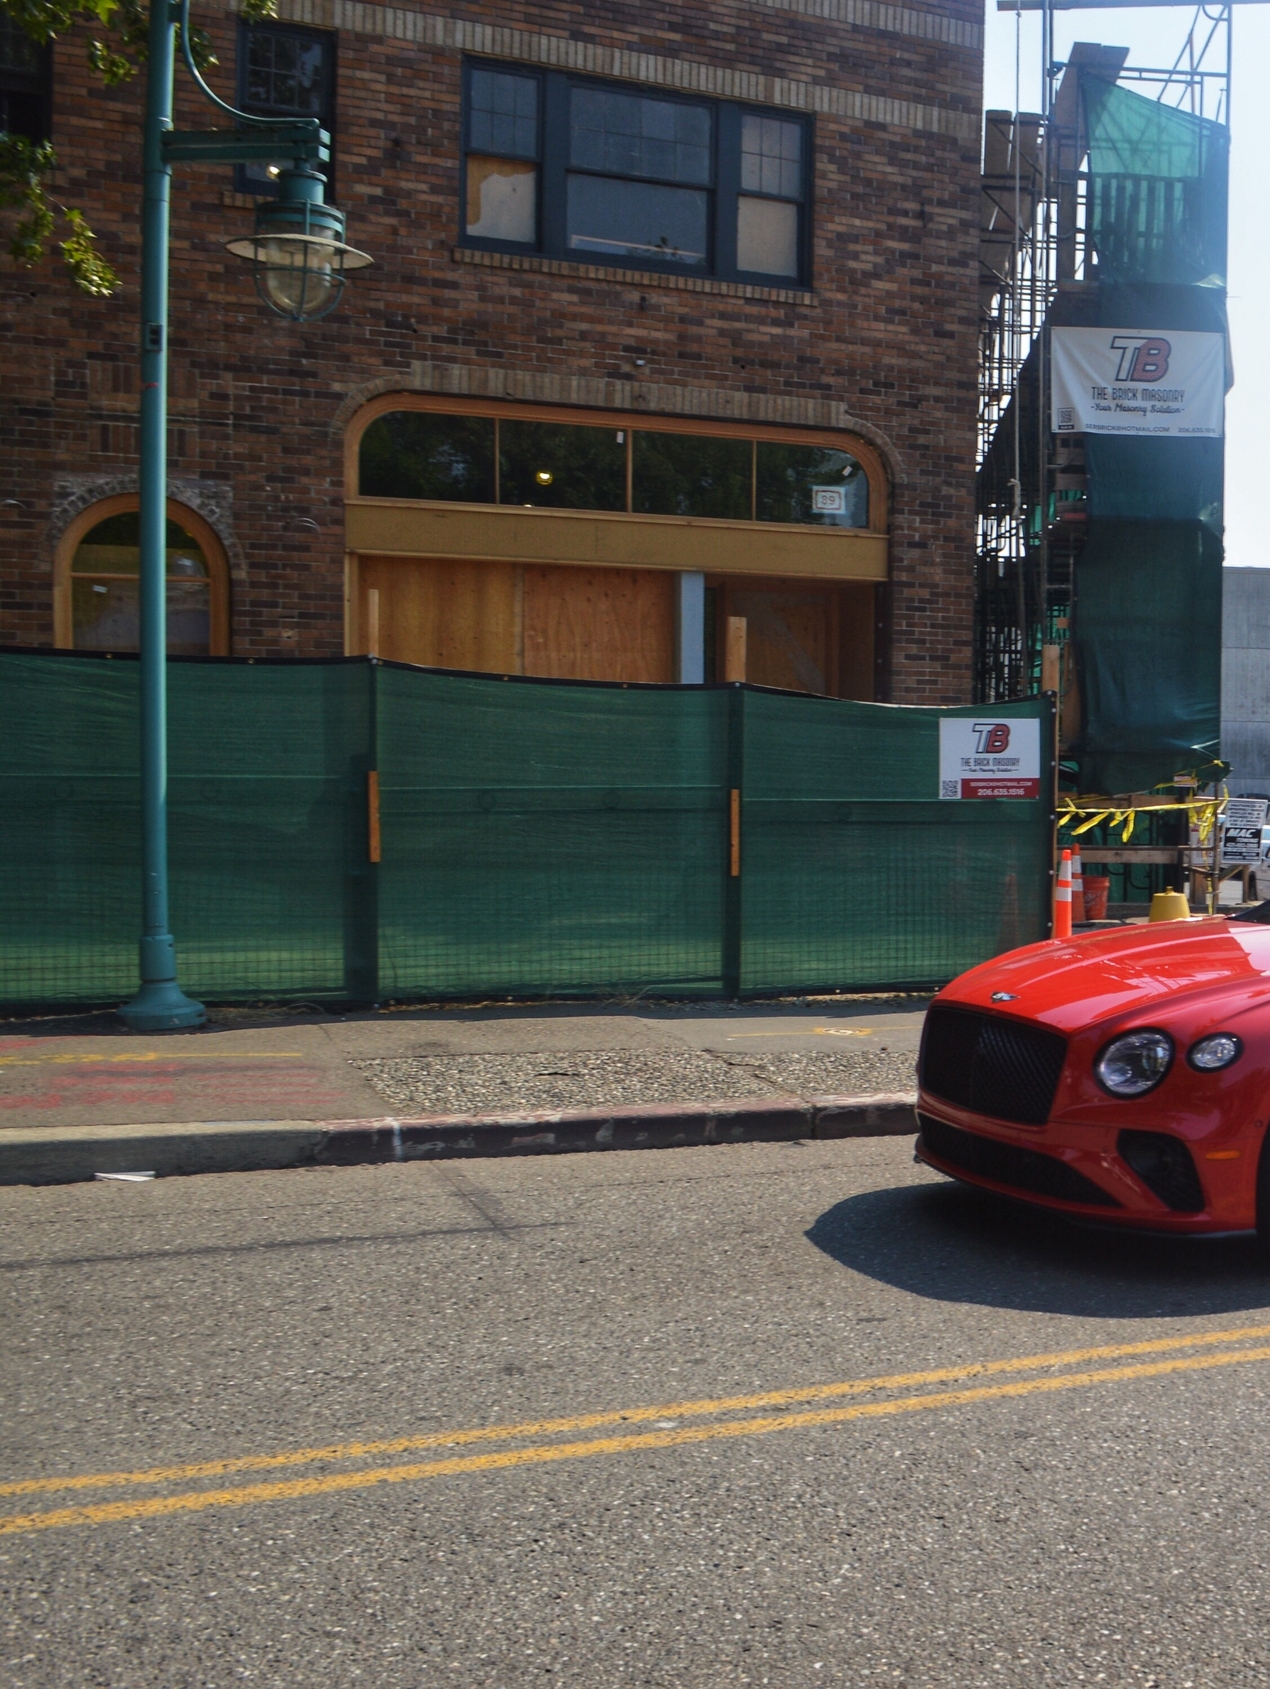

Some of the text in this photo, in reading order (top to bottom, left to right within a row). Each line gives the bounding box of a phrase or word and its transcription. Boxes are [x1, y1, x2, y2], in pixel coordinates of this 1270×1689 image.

[1110, 335, 1172, 383] TB
[1091, 386, 1186, 403] THE BRICK MASONRY
[1114, 402, 1147, 416] Masonry
[971, 723, 1010, 754] TB
[960, 757, 1020, 767] THE BRICK MASONRY
[1226, 829, 1256, 837] MAC
